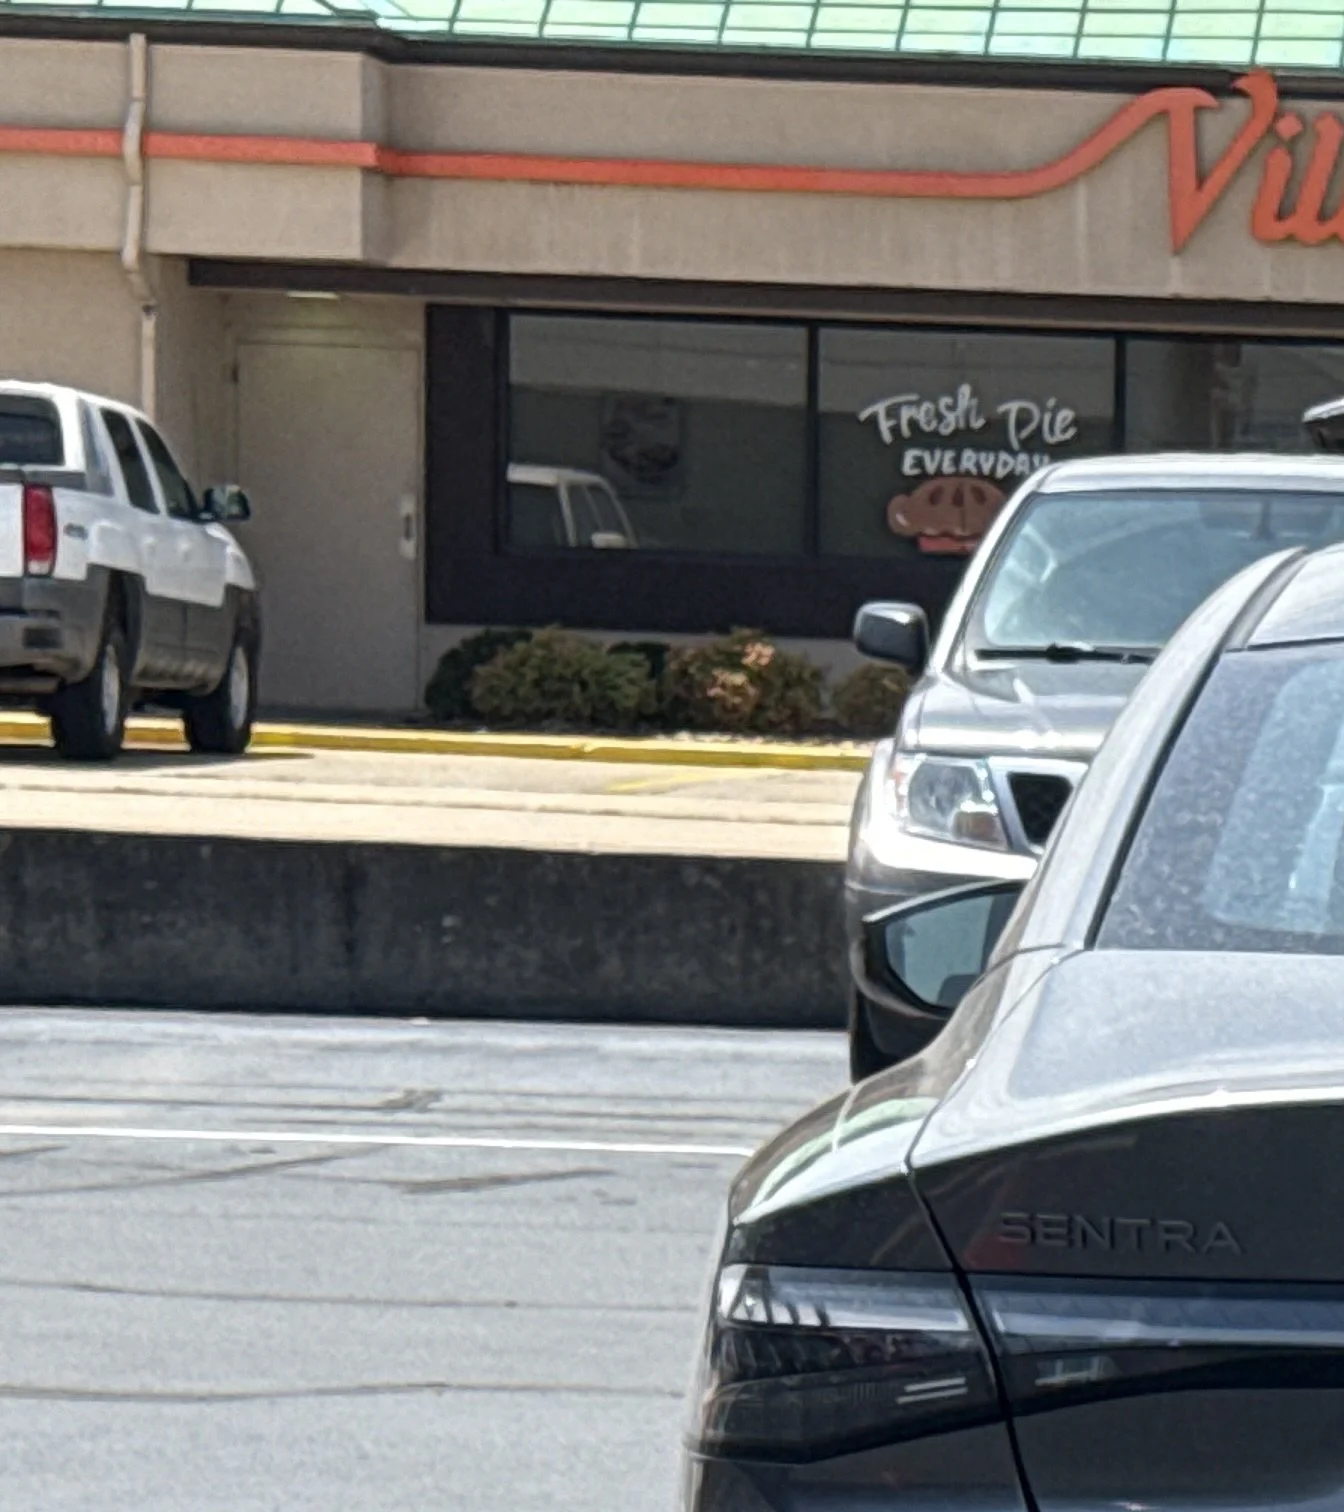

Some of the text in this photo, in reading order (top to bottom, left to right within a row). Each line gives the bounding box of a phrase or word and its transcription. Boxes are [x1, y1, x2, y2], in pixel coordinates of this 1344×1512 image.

[858, 383, 1078, 450] Fresh Pie
[998, 1211, 1245, 1254] SENTRA
